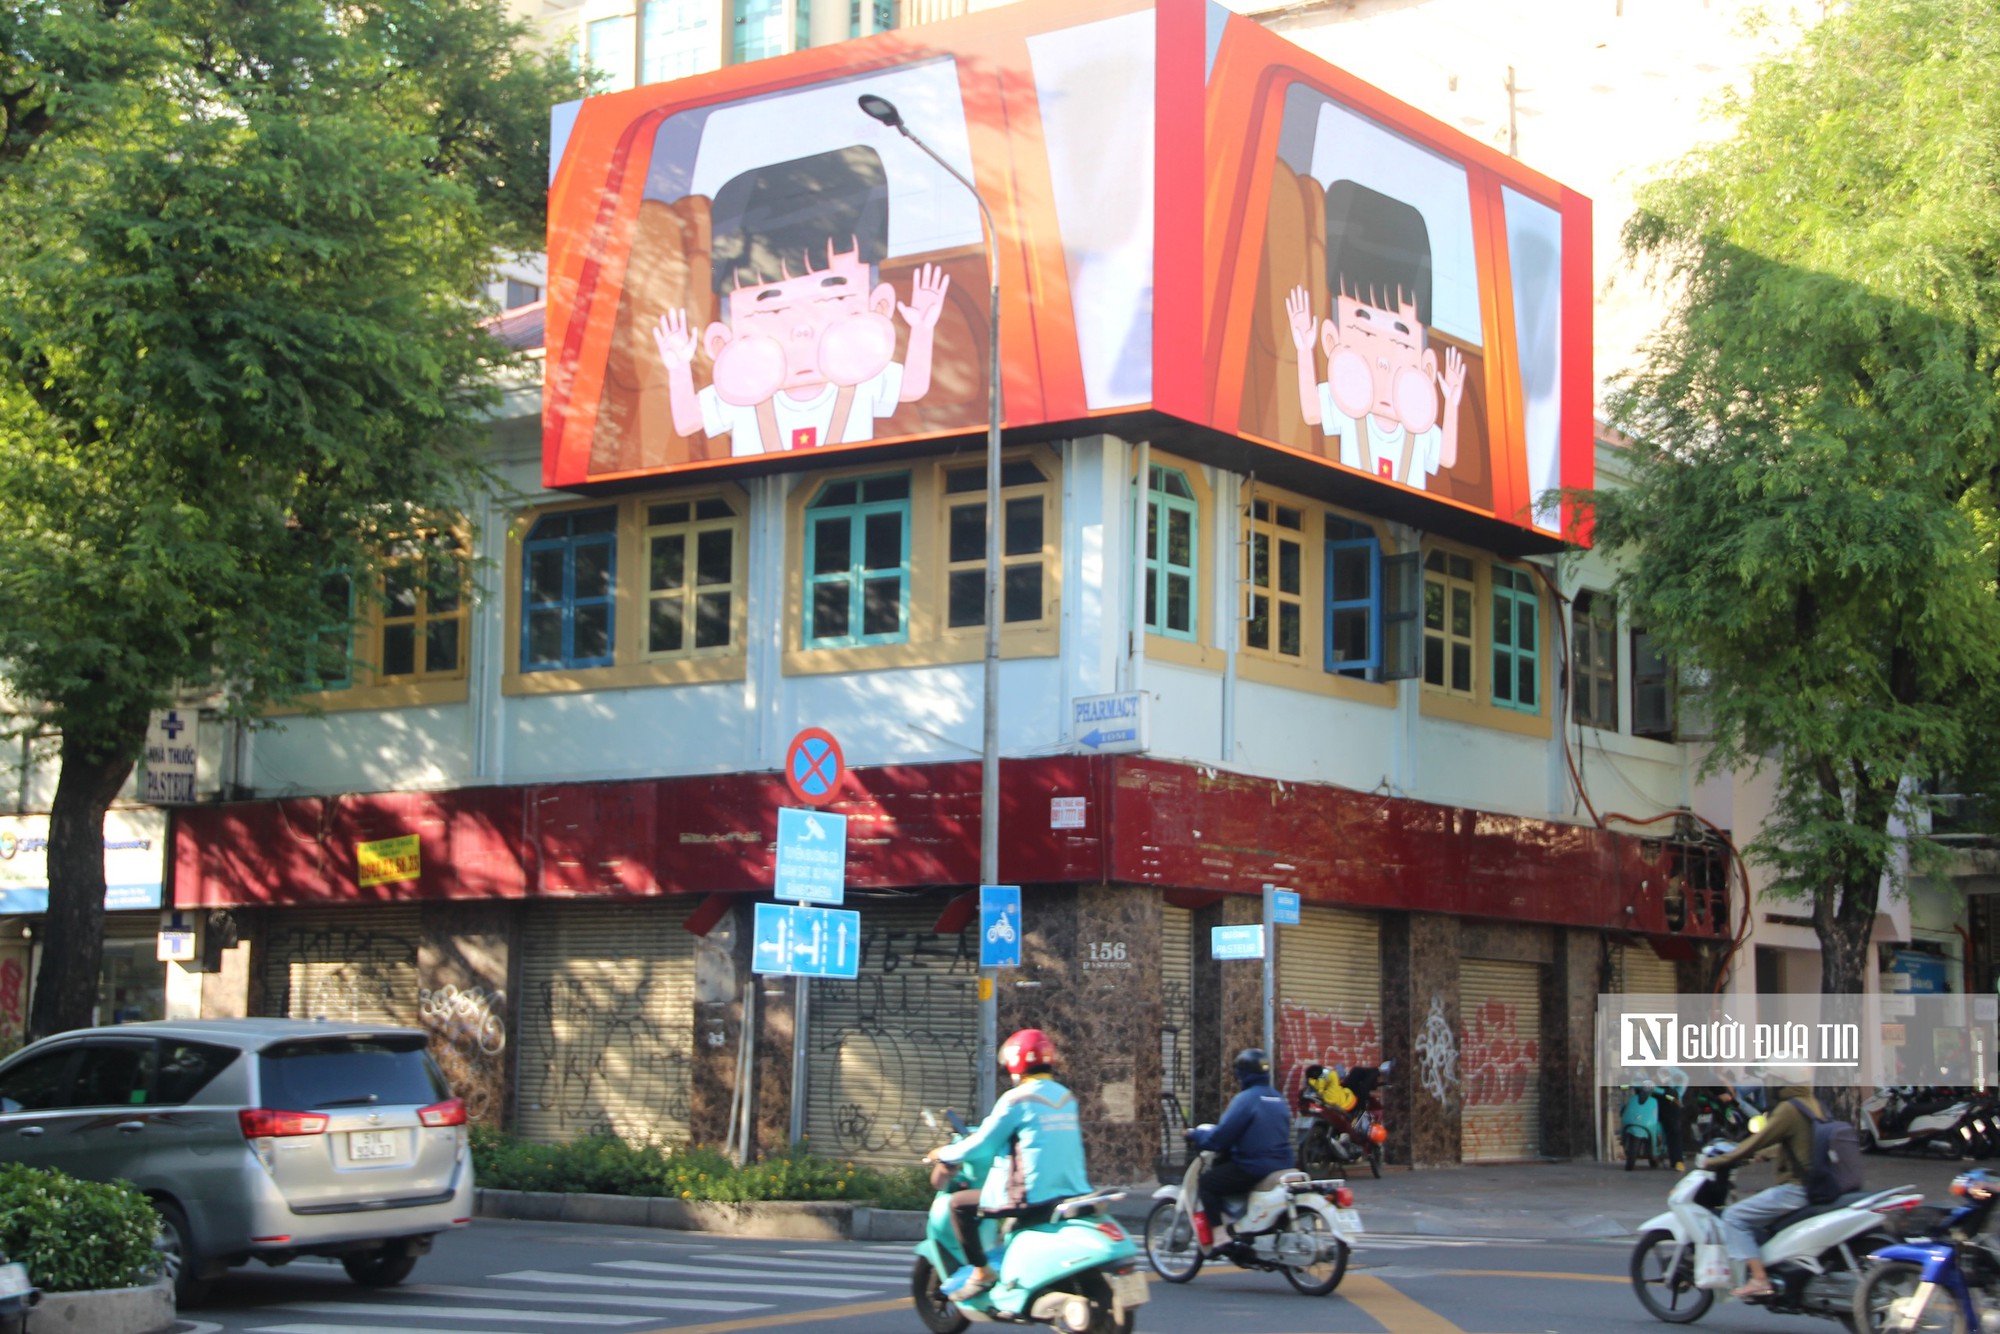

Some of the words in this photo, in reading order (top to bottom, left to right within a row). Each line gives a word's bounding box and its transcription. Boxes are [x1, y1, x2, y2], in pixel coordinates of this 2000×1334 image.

[1076, 696, 1138, 723] PHARMACY
[147, 771, 195, 801] PASTEUR
[1087, 942, 1127, 961] 156
[1216, 943, 1257, 954] PASTEUR
